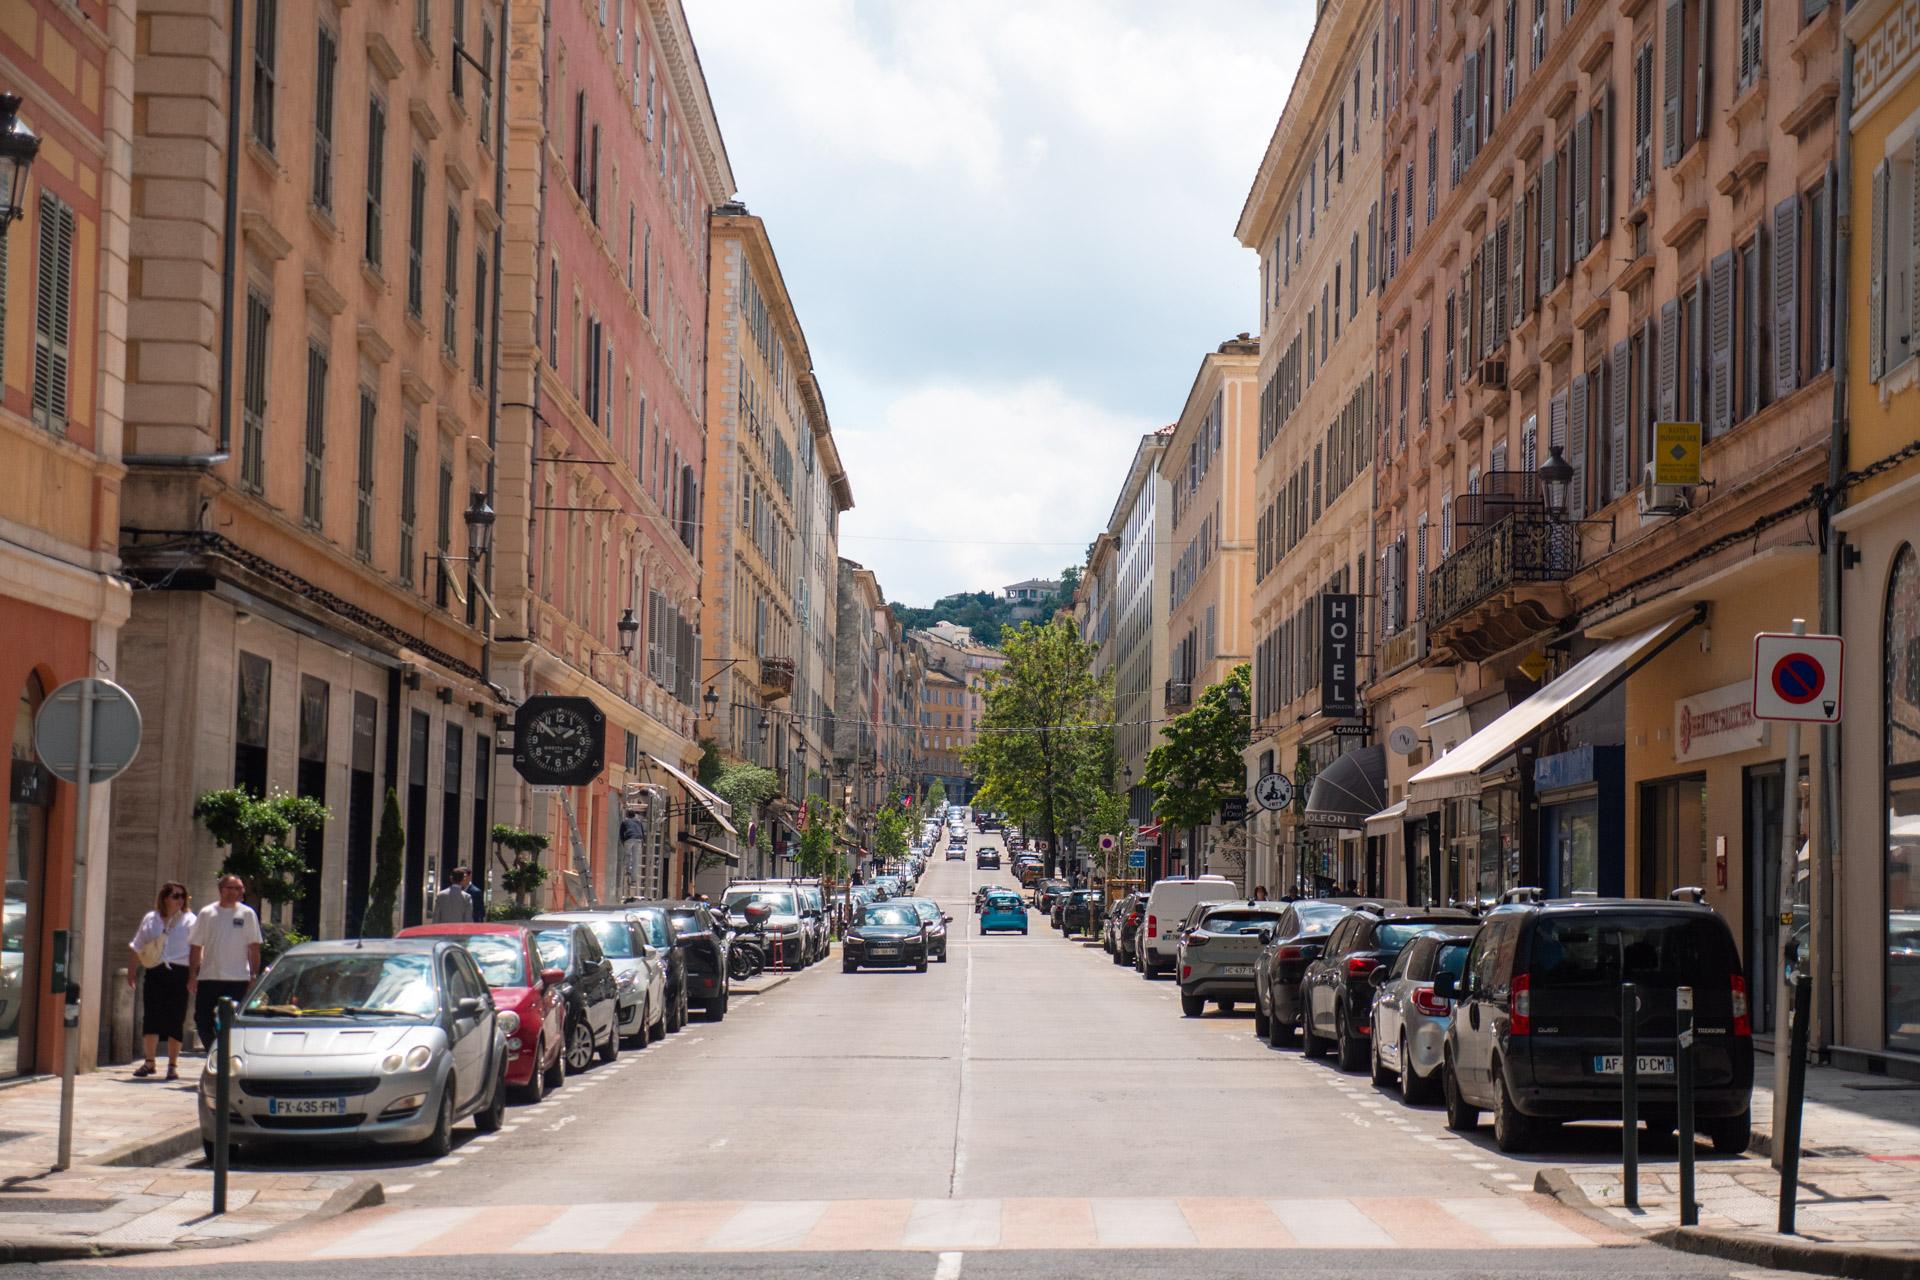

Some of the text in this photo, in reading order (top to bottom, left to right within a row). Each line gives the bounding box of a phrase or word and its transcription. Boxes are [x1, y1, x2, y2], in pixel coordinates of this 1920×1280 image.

[1330, 602, 1348, 701] HOTEL
[545, 716, 551, 725] 11
[556, 713, 565, 722] 12
[569, 716, 574, 726] 1
[536, 724, 545, 733] 10
[576, 725, 583, 734] 2
[532, 735, 538, 744] 9
[579, 736, 586, 746] 3
[535, 747, 542, 756] 8
[575, 748, 581, 757] 4
[545, 755, 551, 764] 7
[555, 758, 561, 767] 6
[567, 756, 573, 765] 5
[1605, 1058, 1665, 1071] AF-0-CM
[277, 1101, 337, 1113] FX-435-FM
